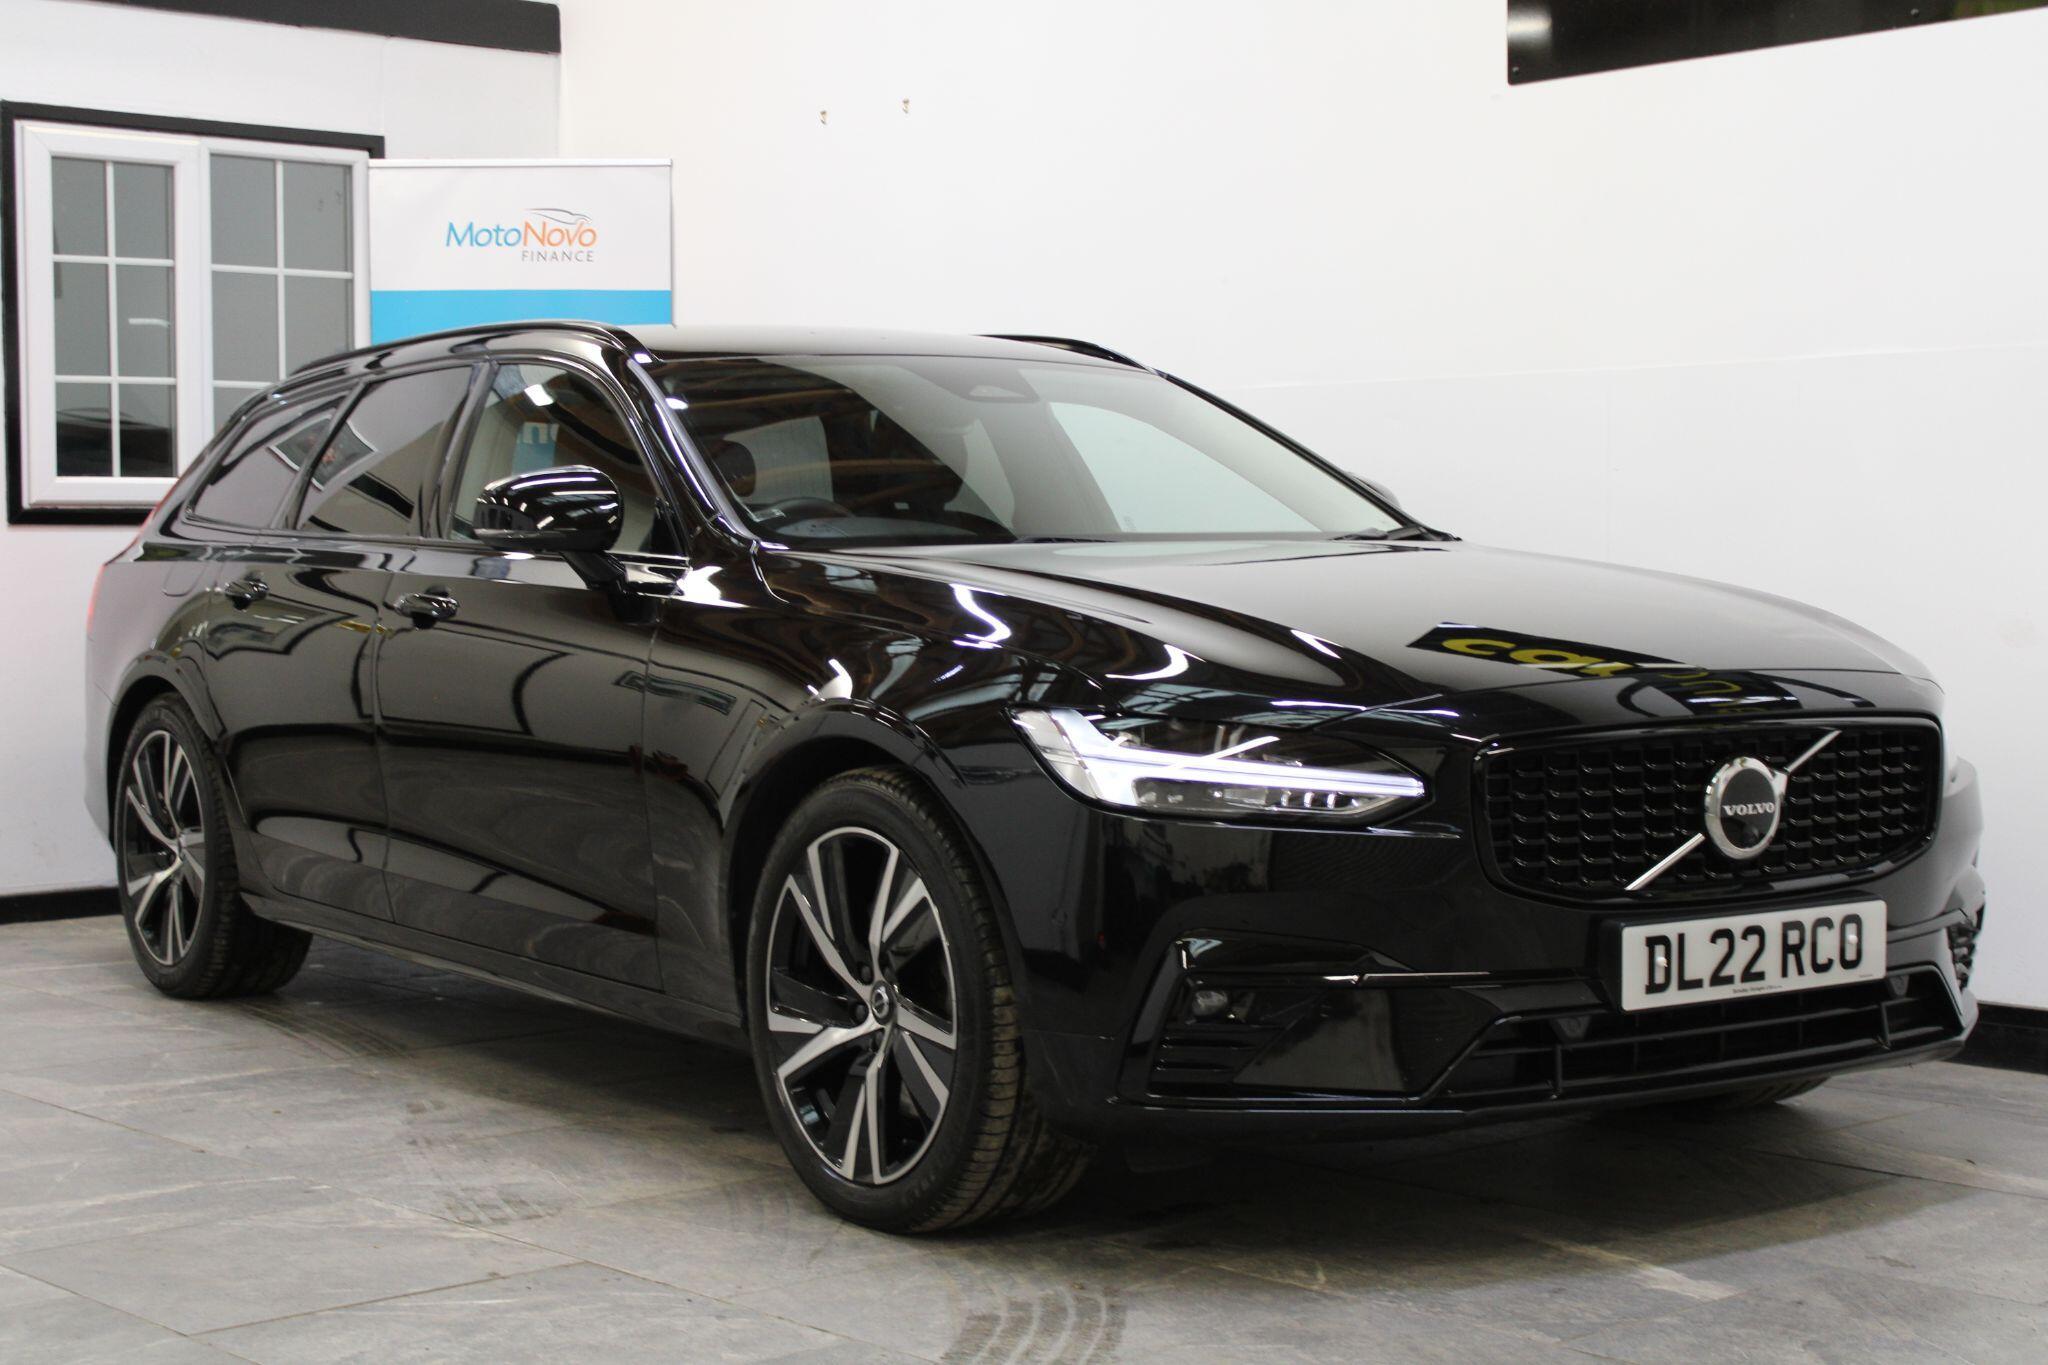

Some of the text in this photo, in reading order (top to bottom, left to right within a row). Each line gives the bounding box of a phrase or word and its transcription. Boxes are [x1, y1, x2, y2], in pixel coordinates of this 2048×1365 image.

[445, 221, 598, 248] MotoNovo
[521, 250, 595, 263] FINANCE
[1722, 802, 1776, 816] VOLVO
[1644, 913, 1863, 996] DL22 RCO
